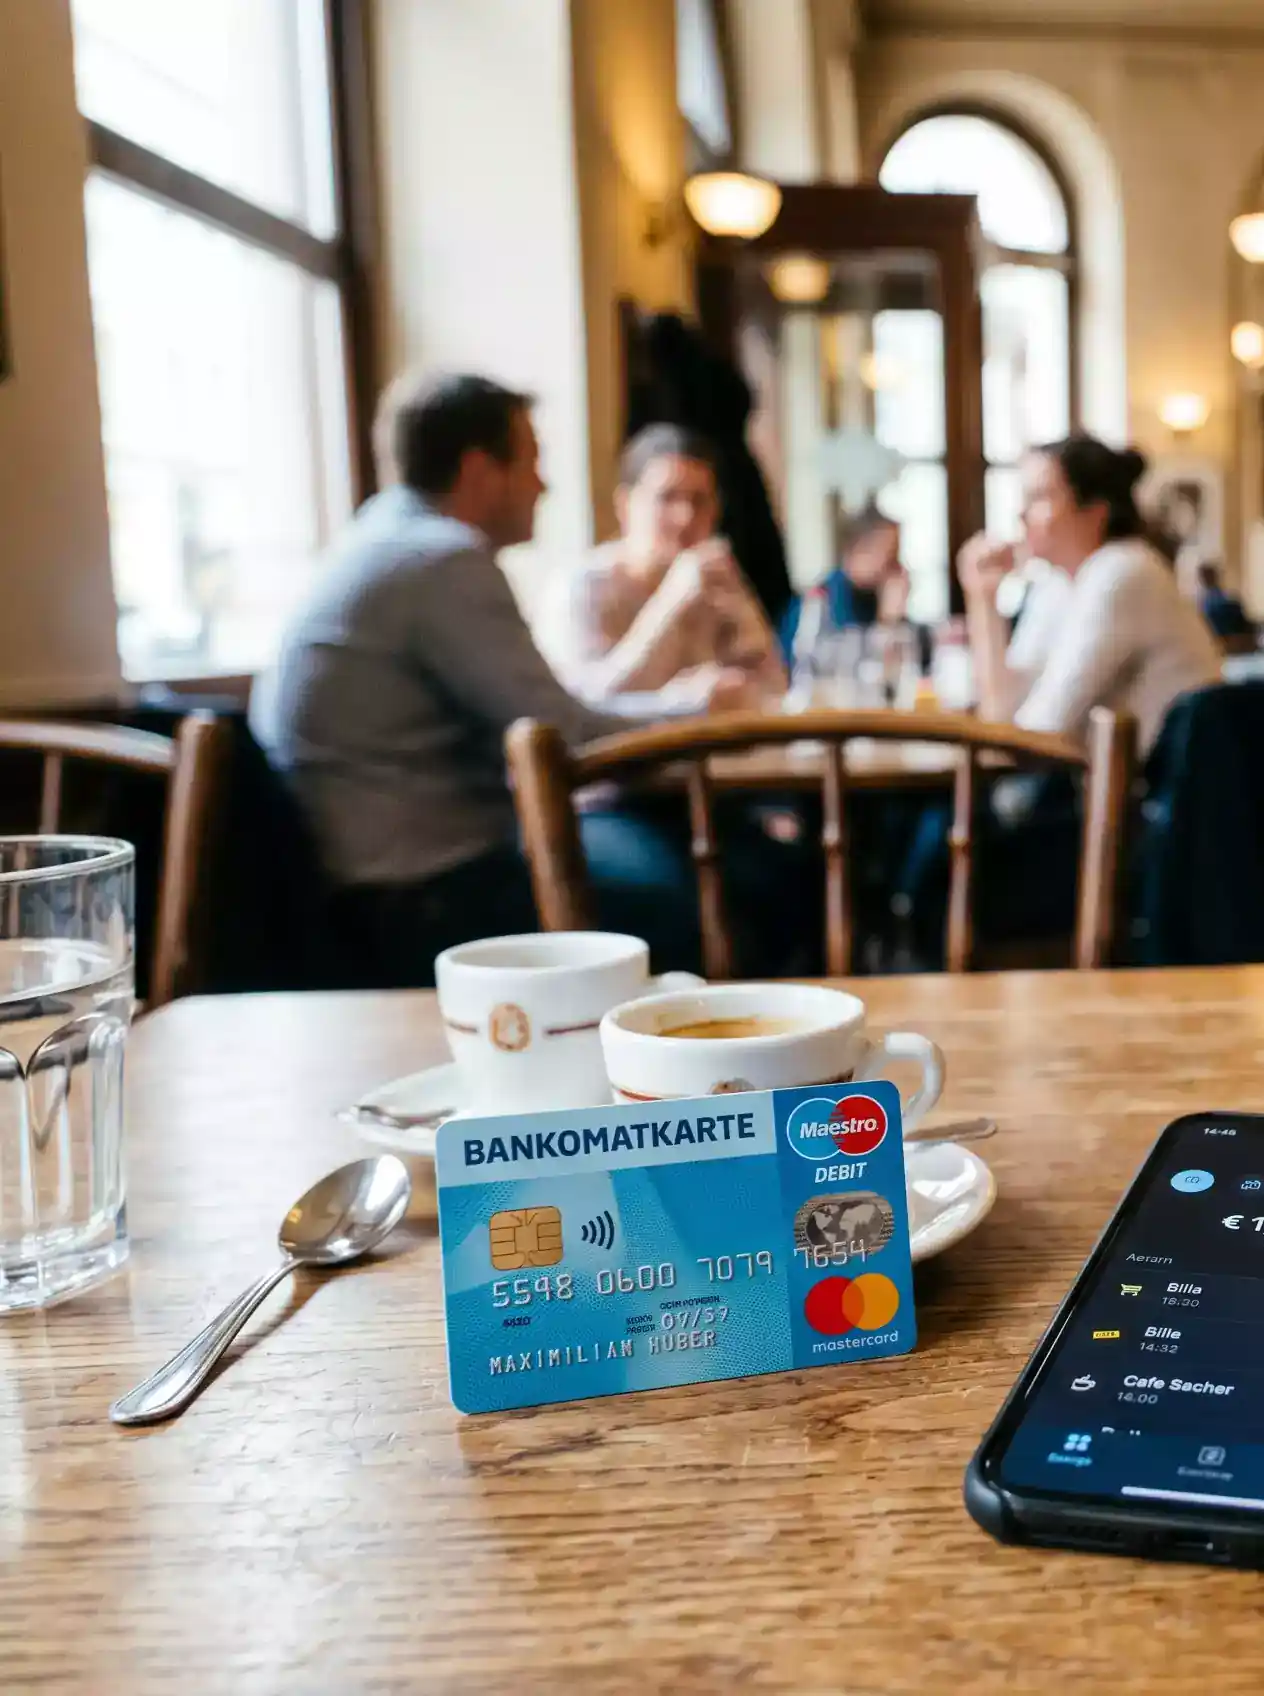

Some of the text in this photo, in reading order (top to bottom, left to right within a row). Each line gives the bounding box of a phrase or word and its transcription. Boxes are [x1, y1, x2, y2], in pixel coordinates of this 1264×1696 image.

[463, 1112, 756, 1166] BANKOMATKARTE
[799, 1118, 878, 1139] Maestro
[814, 1162, 868, 1183] DEBIT
[1221, 1214, 1244, 1230] €
[492, 1239, 867, 1309] 5598 0600 7079 7654
[1166, 1282, 1203, 1295] Billa
[488, 1329, 717, 1376] MAXIMILIAN HUBER
[812, 1330, 899, 1354] mastercard
[1123, 1374, 1235, 1396] Cafe Sacher
